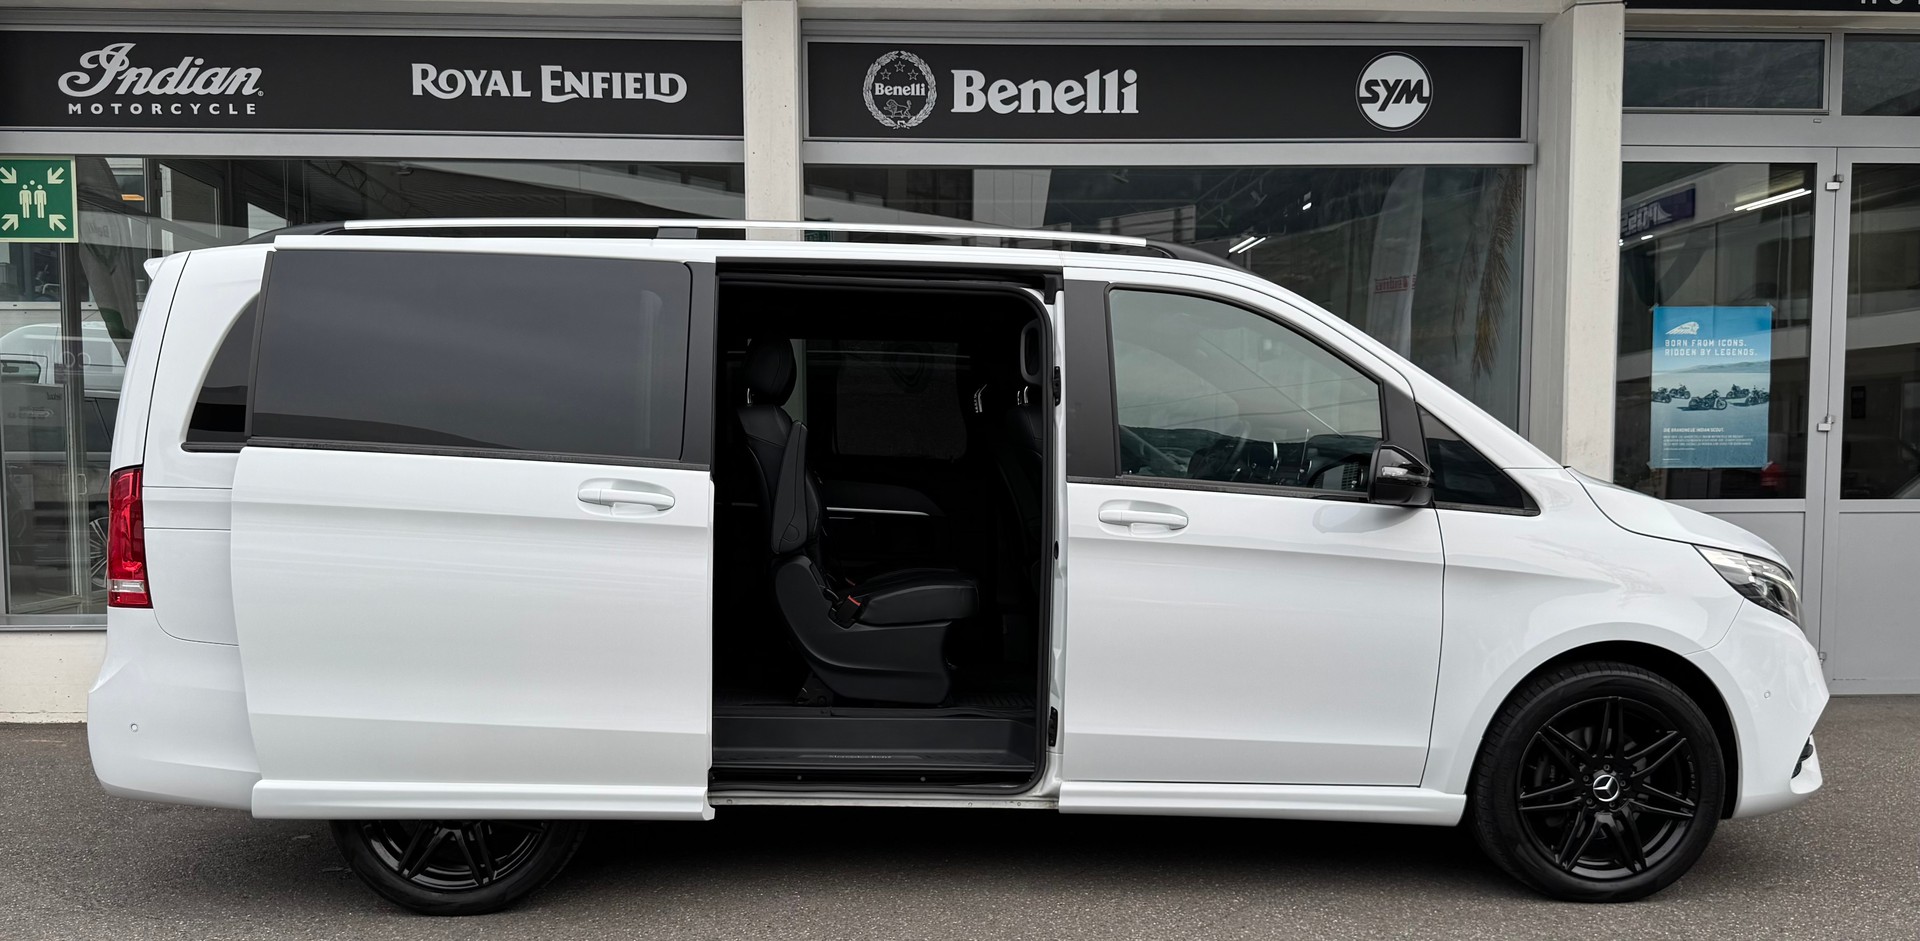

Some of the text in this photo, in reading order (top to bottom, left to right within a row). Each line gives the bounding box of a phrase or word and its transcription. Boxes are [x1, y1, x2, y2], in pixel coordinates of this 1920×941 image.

[411, 63, 688, 103] ROYAL ENFIELD
[874, 82, 926, 96] Benelli
[950, 69, 1139, 115] Benelli
[1359, 79, 1430, 112] SYM
[68, 103, 256, 115] MOTORCYCLE
[1664, 339, 1747, 347] BORN FROM ICONS.
[1664, 348, 1758, 356] RIDDEN BY LEGENDS.
